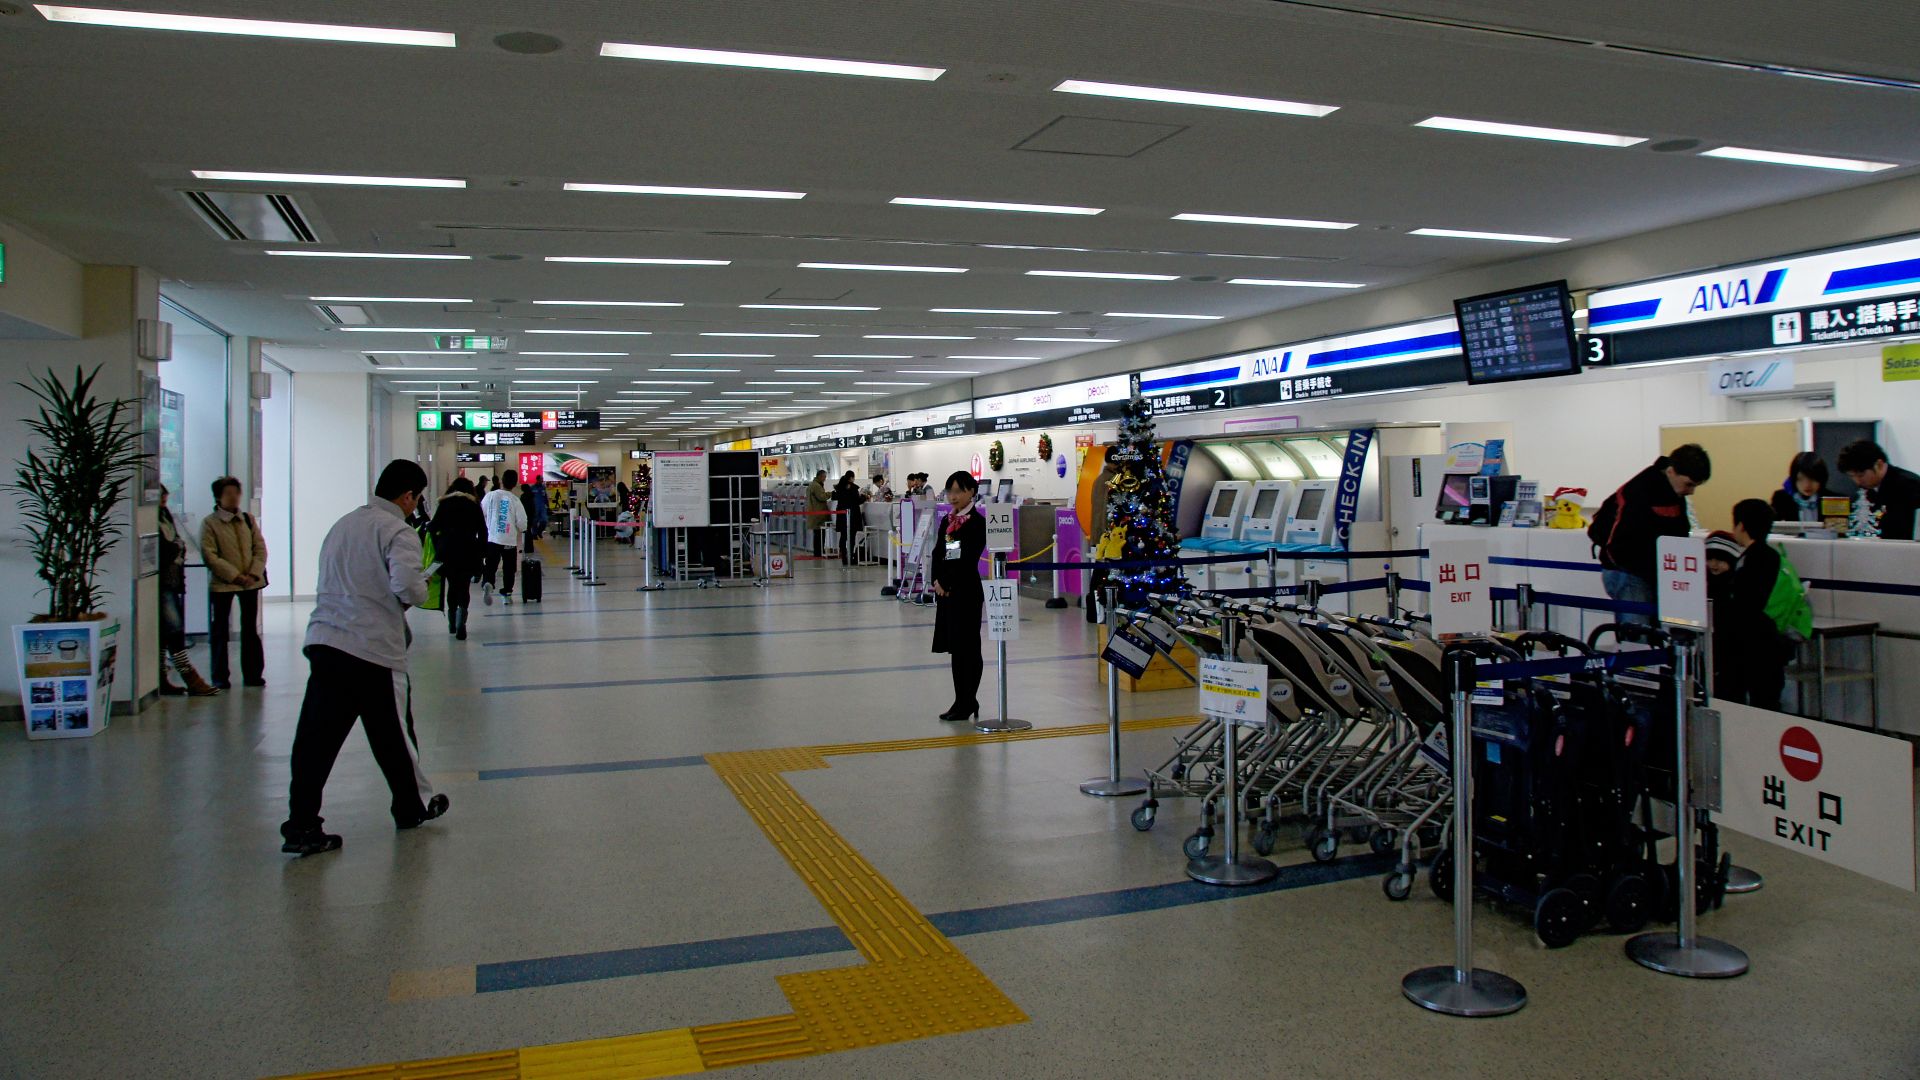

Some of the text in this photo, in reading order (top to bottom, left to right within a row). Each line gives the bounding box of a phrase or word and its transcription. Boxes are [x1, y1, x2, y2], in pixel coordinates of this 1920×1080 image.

[1688, 278, 1751, 314] ANA
[1810, 299, 1920, 330] 購入・搭乗手
[1587, 337, 1605, 363] 3
[1252, 357, 1278, 377] ANA
[1719, 369, 1755, 389] ORC
[1087, 384, 1110, 400] peach
[1214, 389, 1226, 406] 2
[858, 435, 867, 445] 4
[915, 427, 924, 438] 5
[785, 444, 792, 453] 2
[838, 437, 846, 448] 3
[1338, 432, 1368, 540] CHECK-IN
[989, 514, 1010, 524] 入口
[1058, 515, 1075, 527] peach
[1664, 553, 1697, 573] 出口
[1439, 563, 1480, 584] 出口
[989, 585, 1012, 602] 入口
[1672, 580, 1690, 591] EXIT
[1450, 591, 1472, 603] EXIT
[1584, 657, 1606, 670] ANA
[1763, 775, 1843, 826] 出口
[1775, 816, 1832, 852] EXIT
